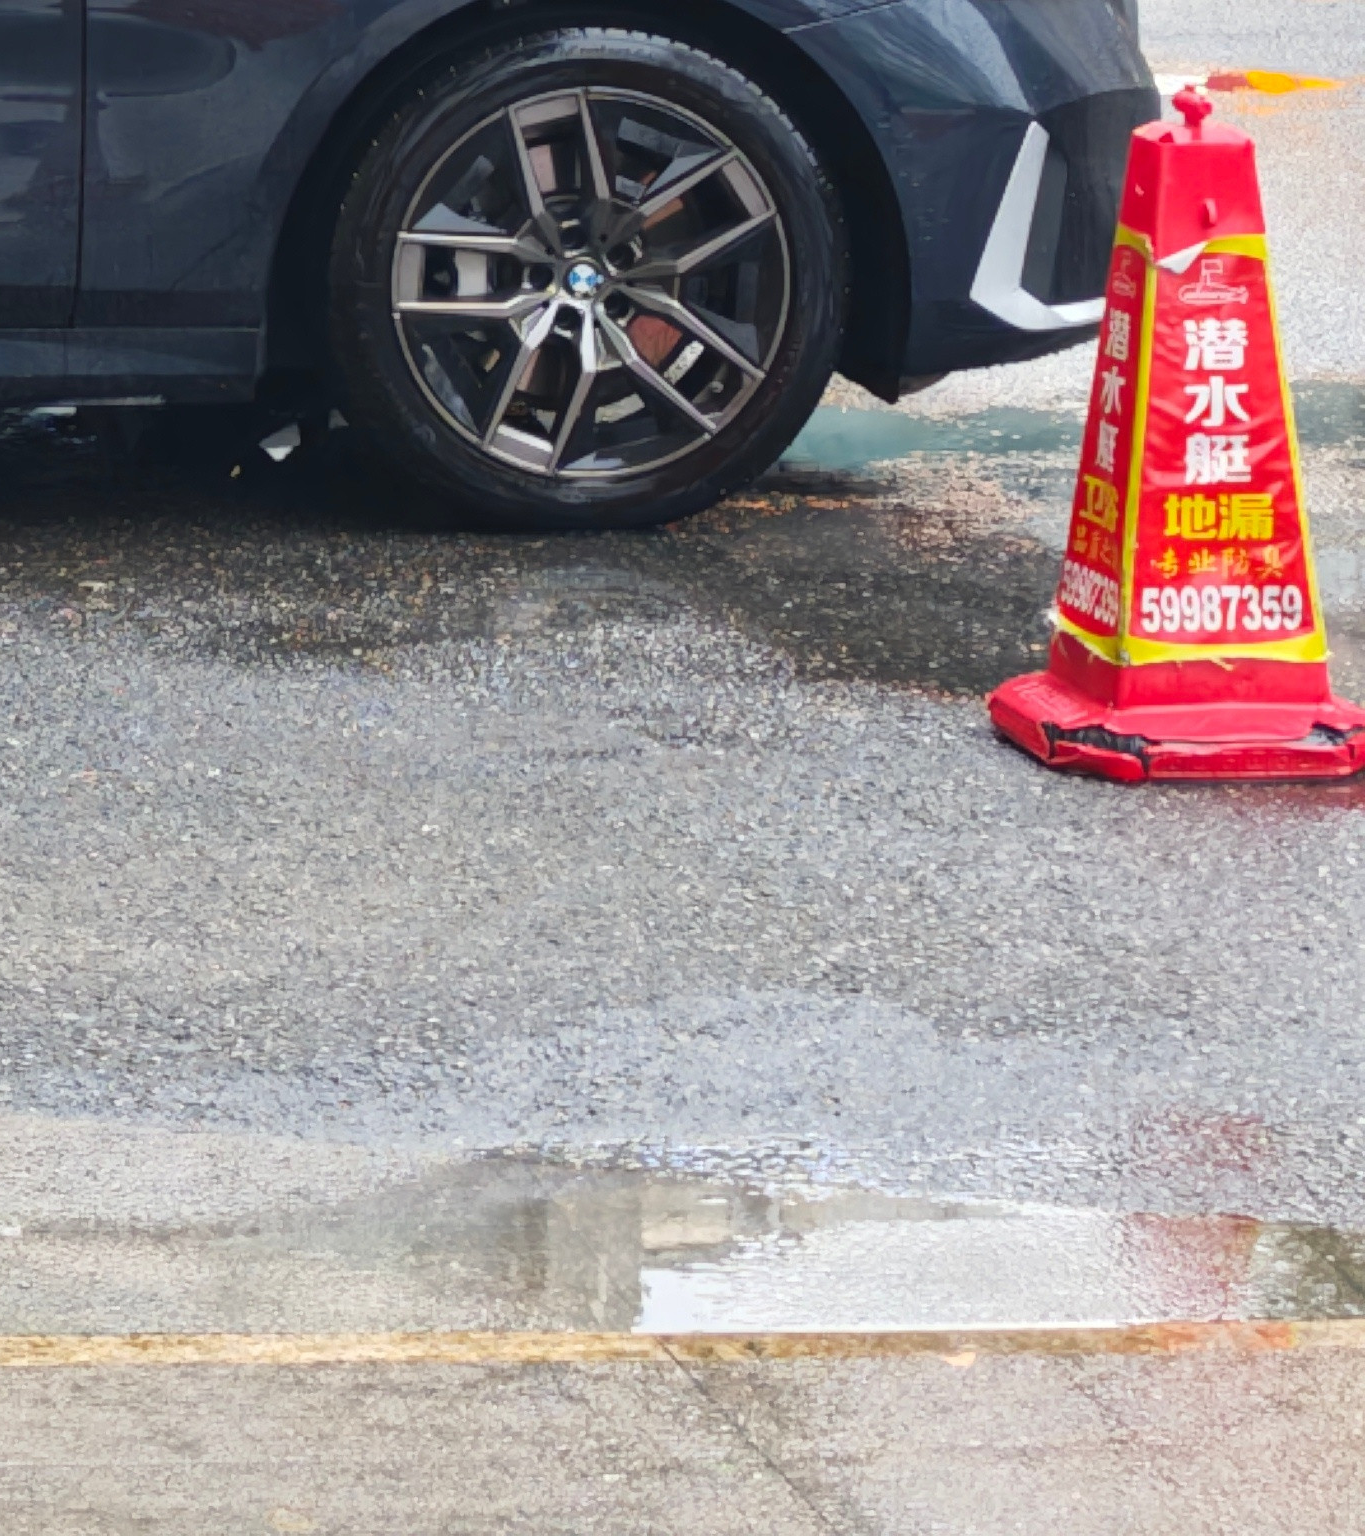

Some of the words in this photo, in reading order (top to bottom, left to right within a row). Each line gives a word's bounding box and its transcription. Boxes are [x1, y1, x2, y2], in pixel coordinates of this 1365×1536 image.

[1183, 319, 1252, 486] 潜水艇
[1163, 493, 1275, 542] 地漏
[1140, 583, 1305, 634] 59987359
